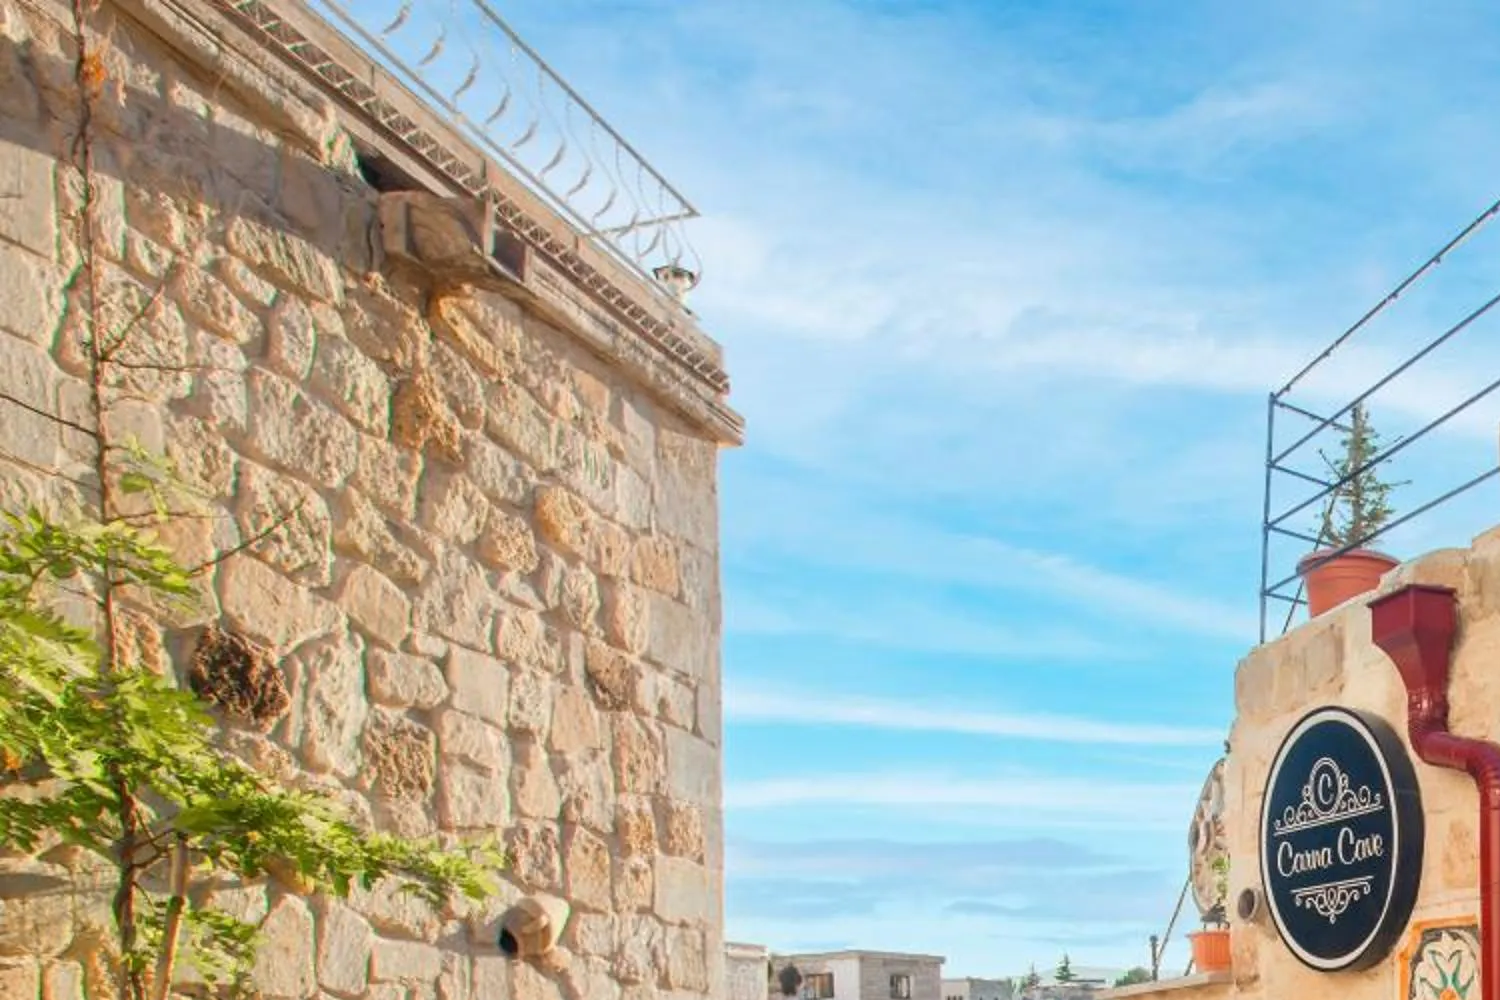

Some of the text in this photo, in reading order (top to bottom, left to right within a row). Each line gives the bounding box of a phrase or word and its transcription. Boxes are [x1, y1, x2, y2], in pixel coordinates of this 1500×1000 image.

[1318, 773, 1333, 805] C
[1277, 827, 1384, 878] Carna Cave
